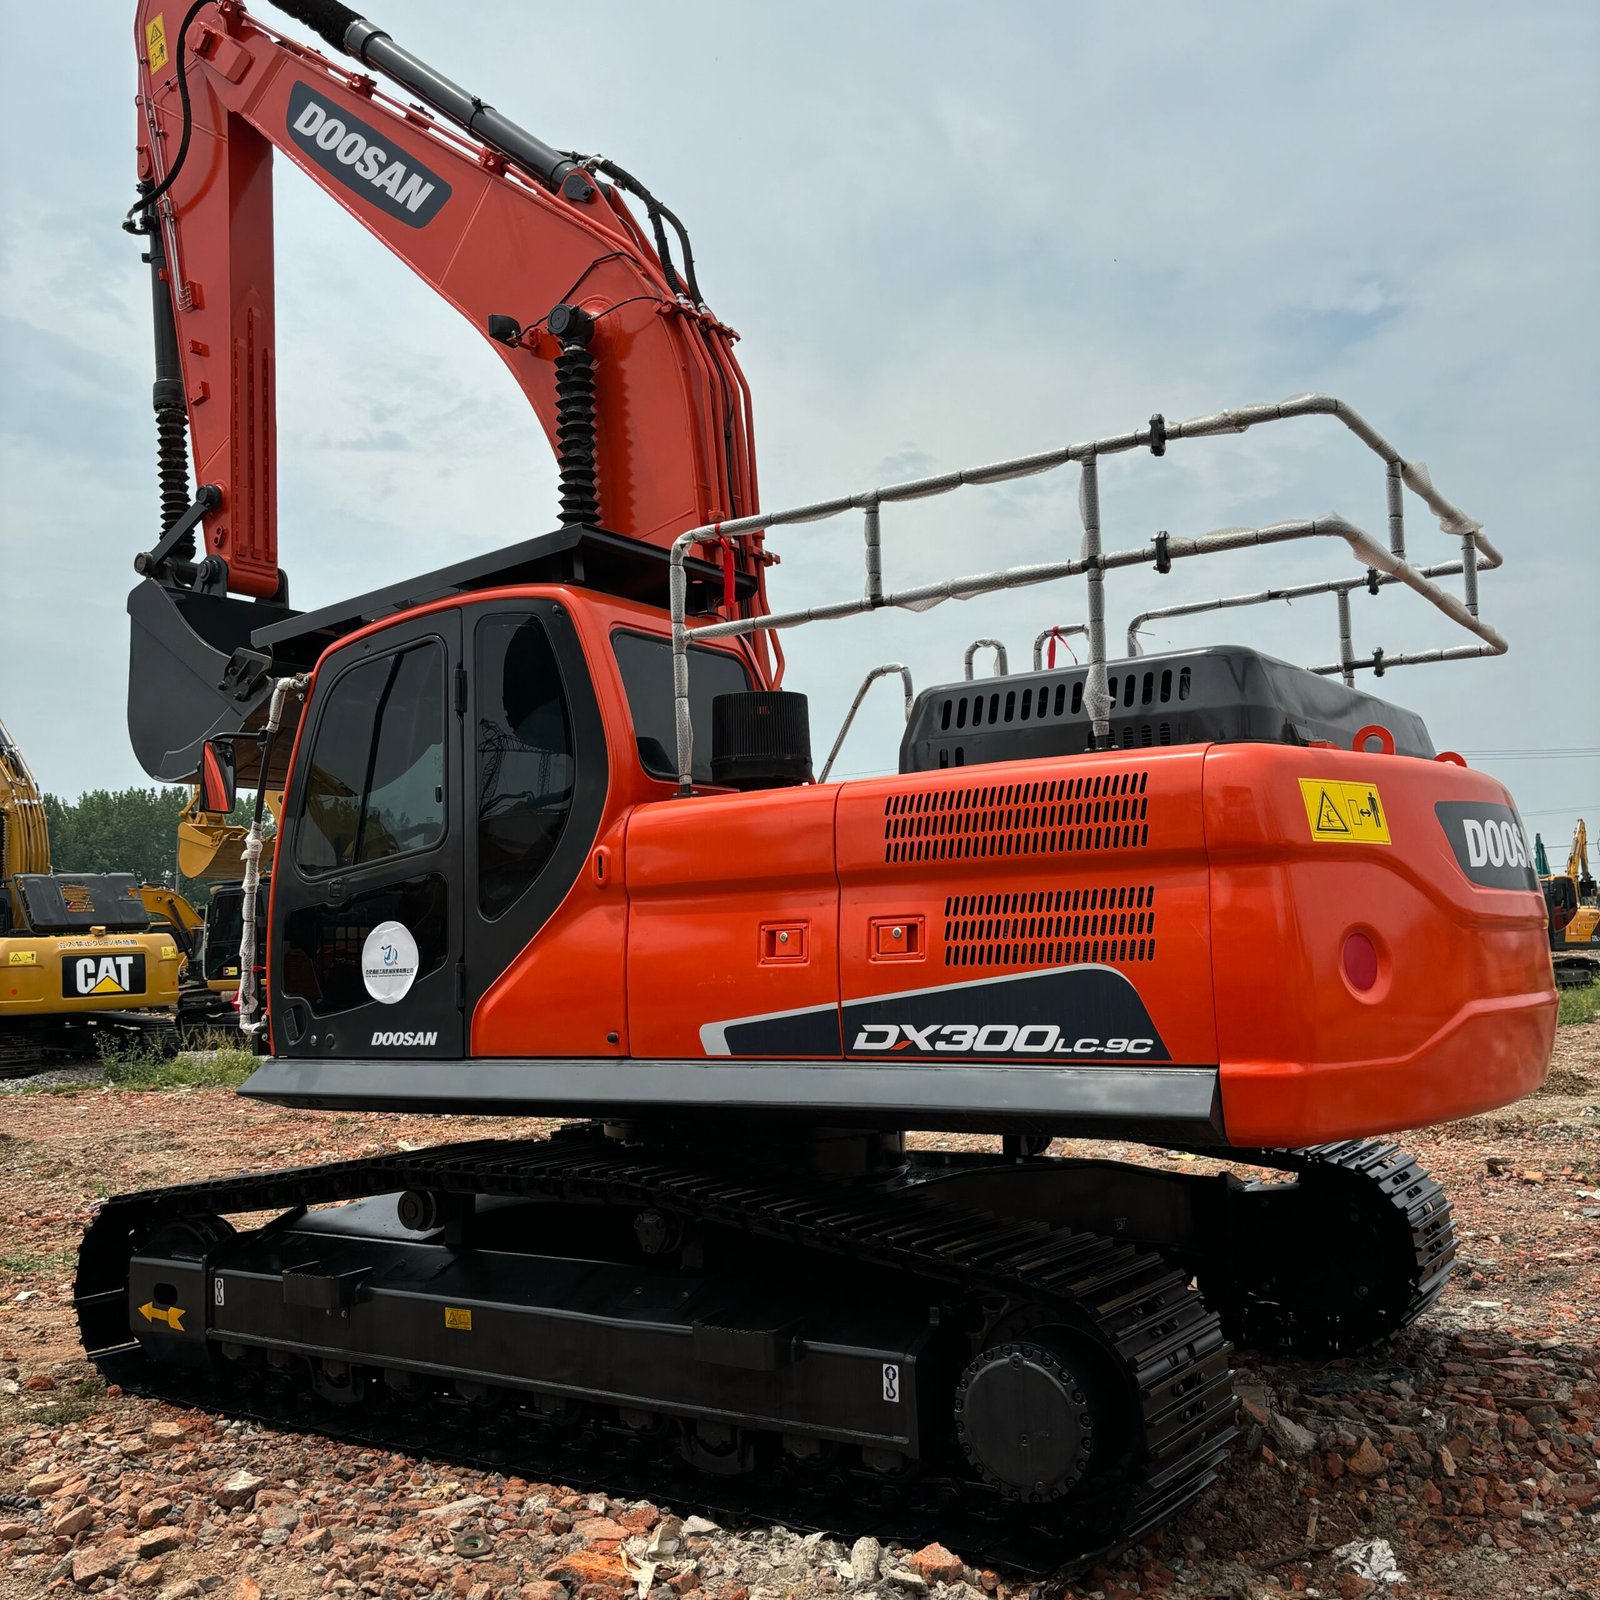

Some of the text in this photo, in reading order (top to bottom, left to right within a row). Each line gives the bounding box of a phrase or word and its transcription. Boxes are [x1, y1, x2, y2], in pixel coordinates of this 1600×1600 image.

[292, 101, 435, 213] DOOSAN
[75, 956, 134, 994] CAT
[371, 1031, 438, 1046] DOOSAN
